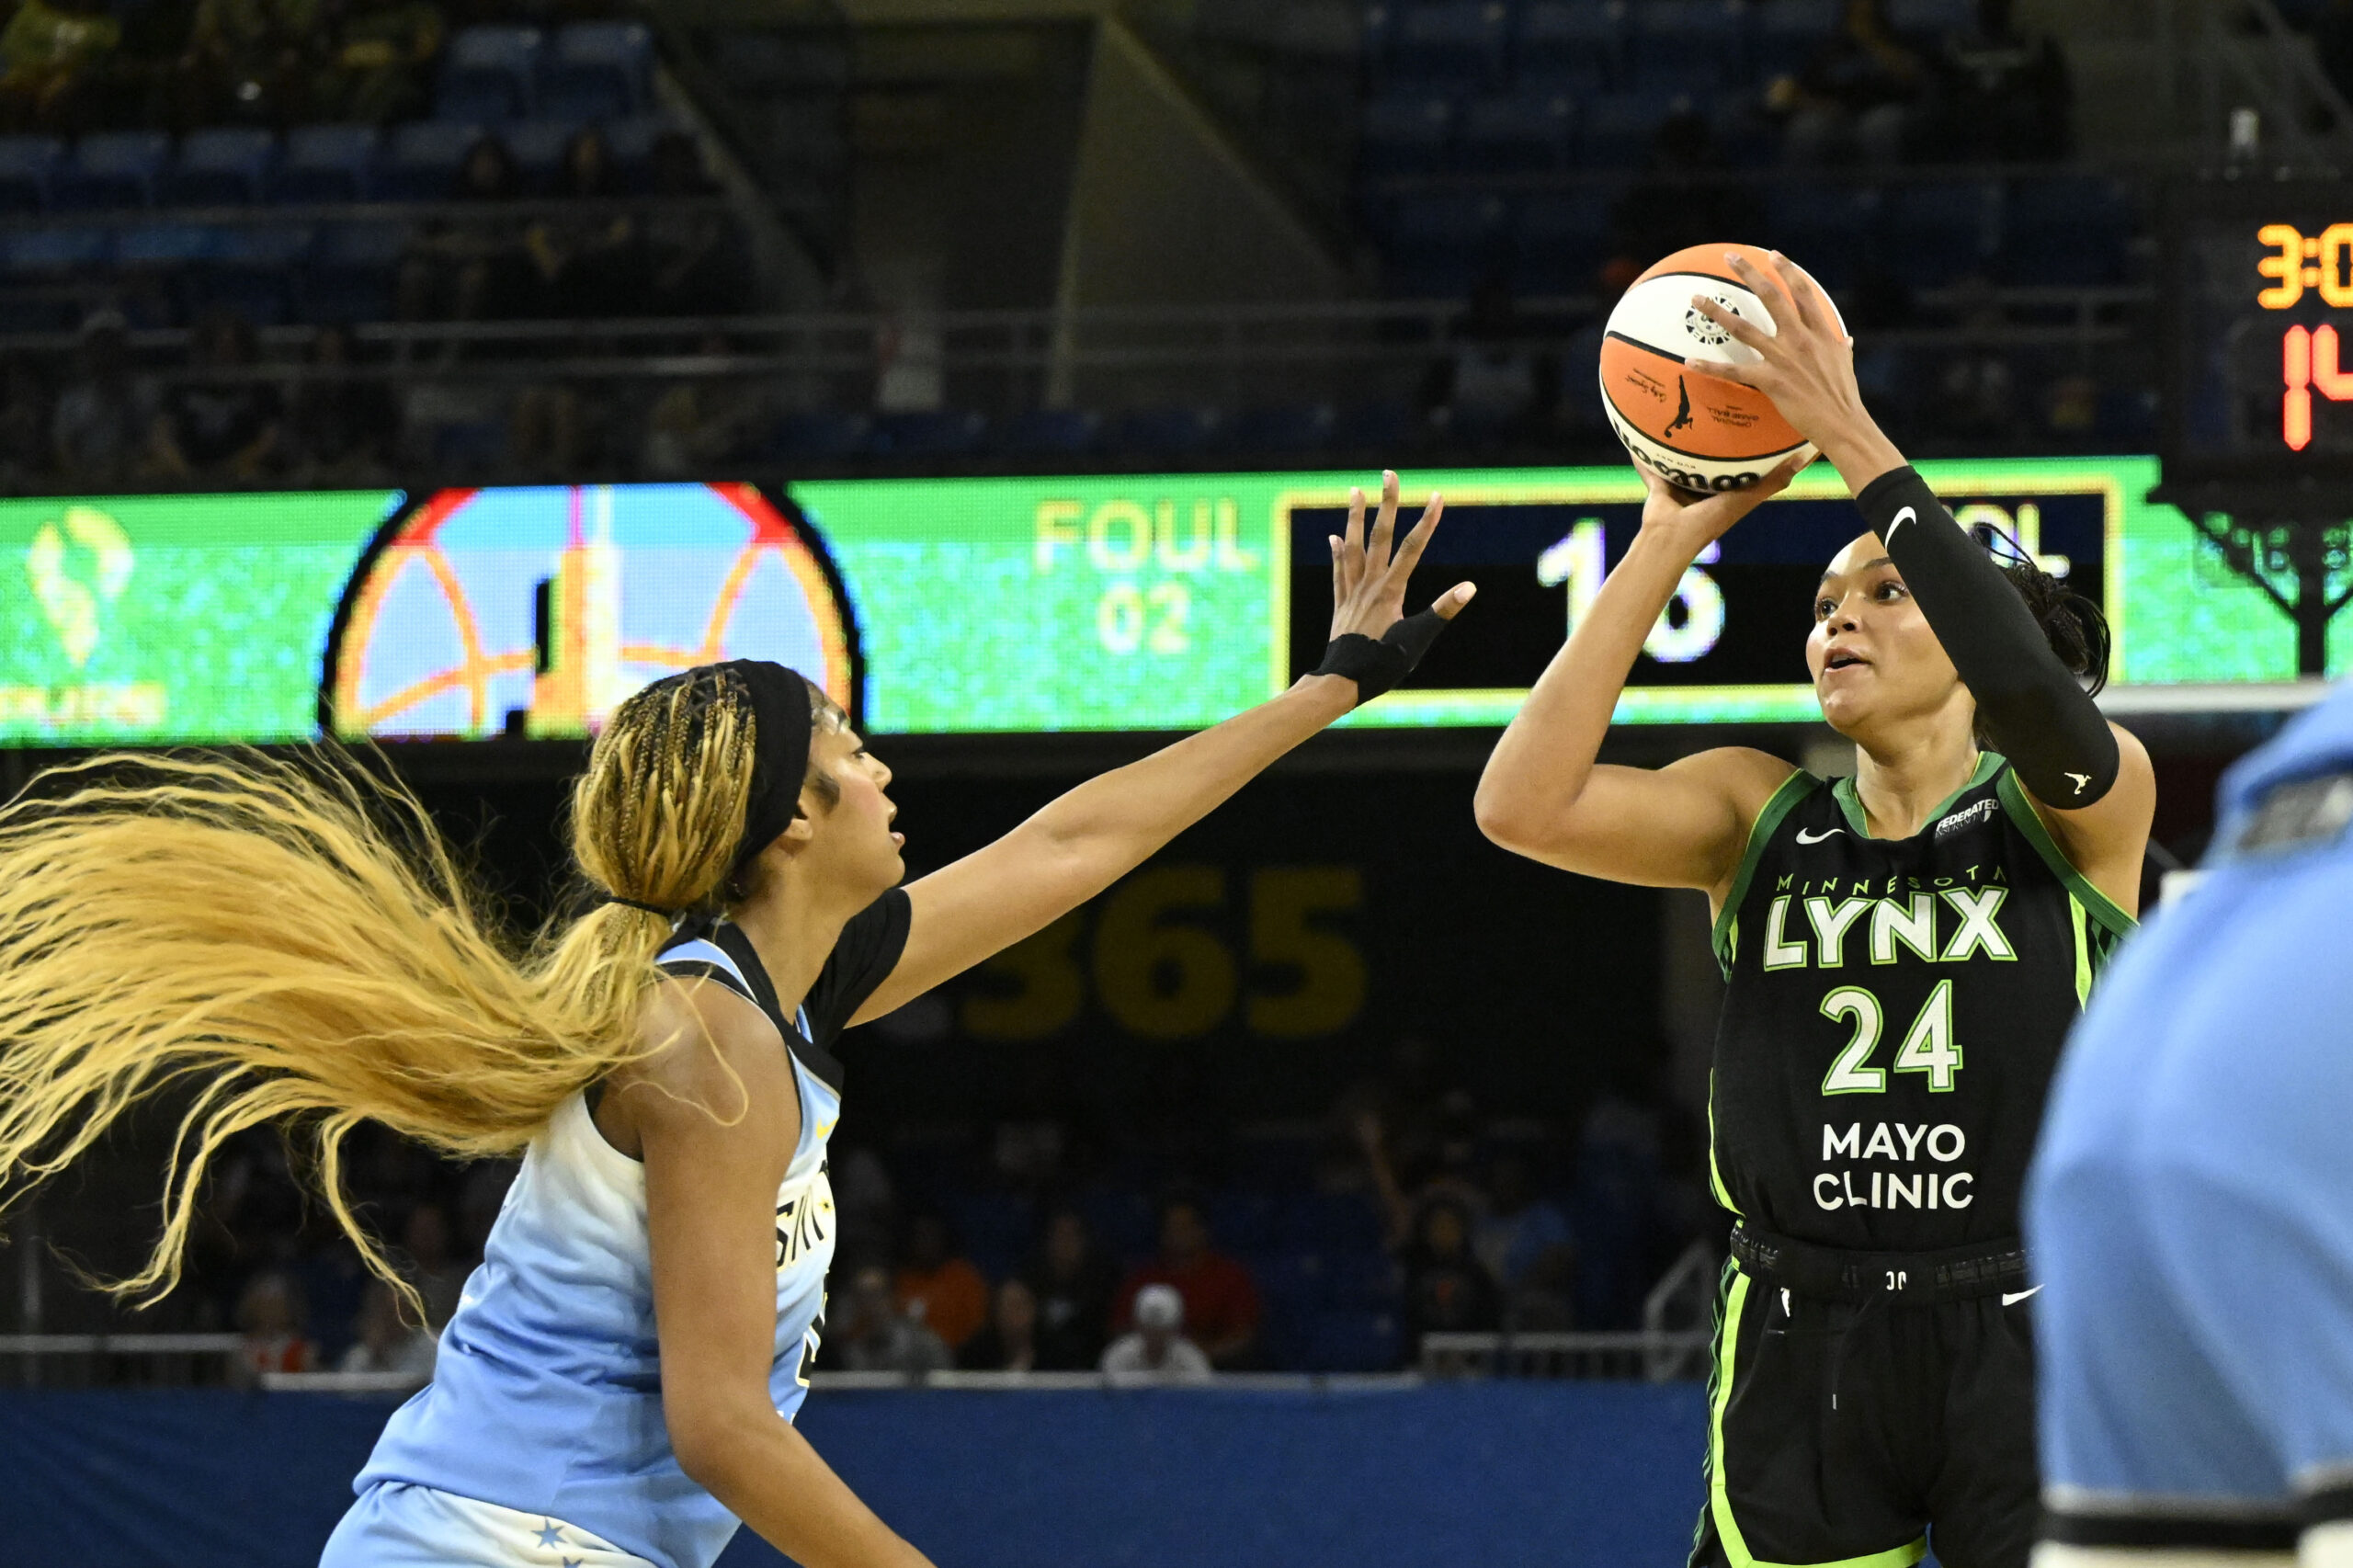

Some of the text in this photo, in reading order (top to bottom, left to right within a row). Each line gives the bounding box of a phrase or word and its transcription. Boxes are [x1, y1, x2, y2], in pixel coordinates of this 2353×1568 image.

[1036, 498, 1260, 574] FOUL
[1098, 583, 1192, 654] 02
[1935, 798, 1999, 832] FEDERATED
[1776, 864, 2007, 897] MINNESOTA
[1763, 884, 2018, 971] LYNX
[1819, 979, 1963, 1096] 24
[1822, 1121, 1966, 1162] MAYO
[1813, 1170, 1974, 1211] CLINIC
